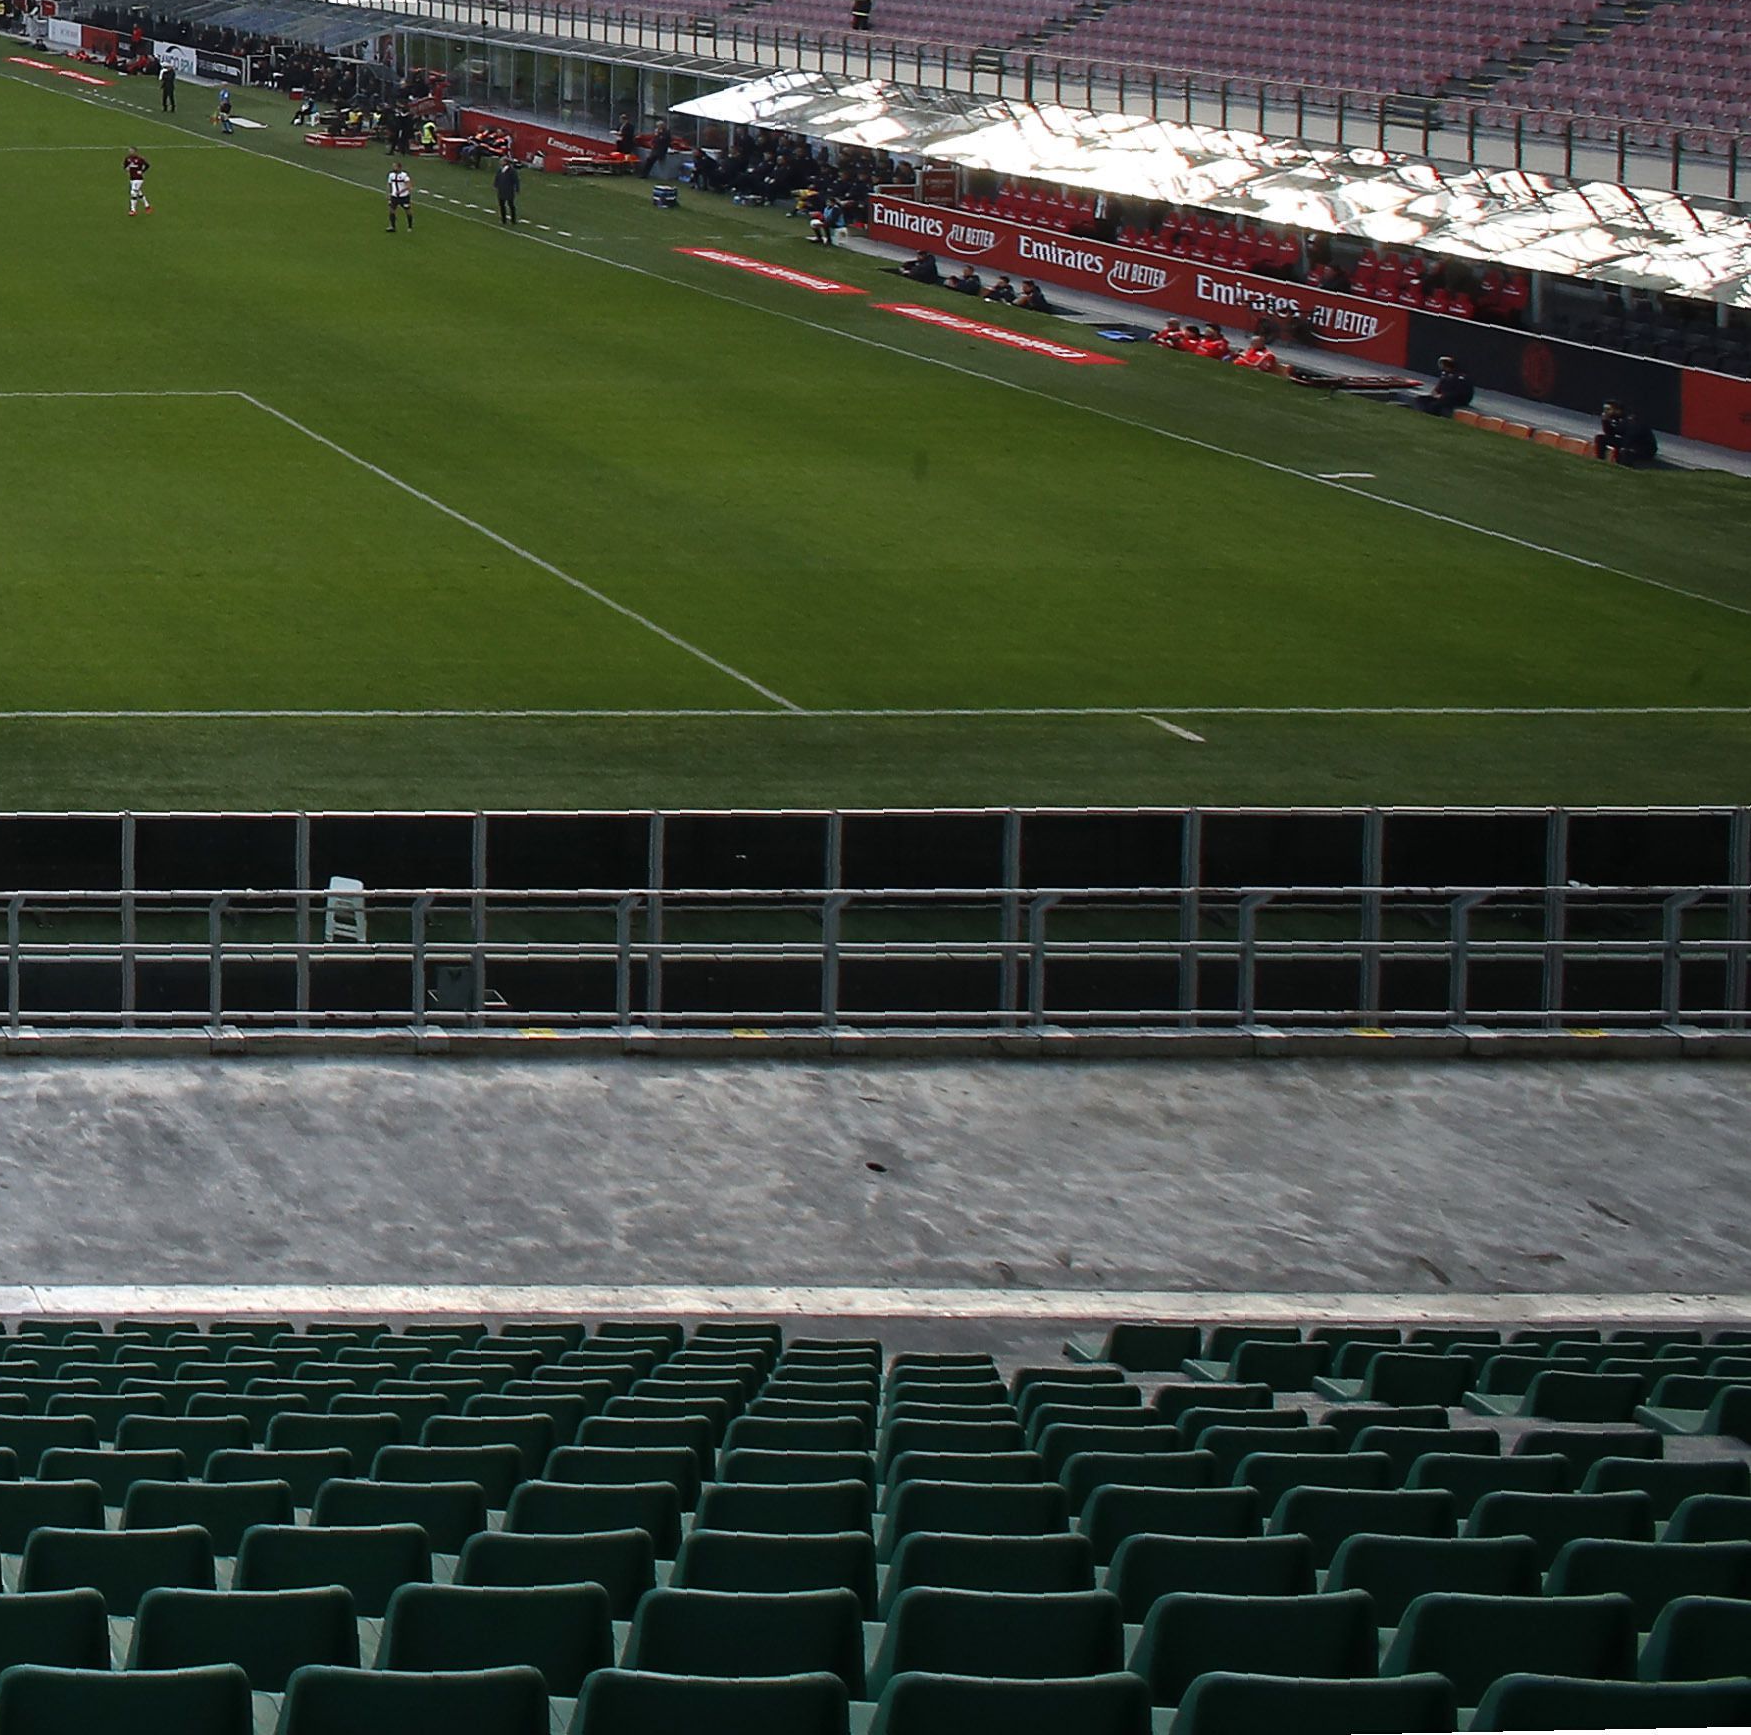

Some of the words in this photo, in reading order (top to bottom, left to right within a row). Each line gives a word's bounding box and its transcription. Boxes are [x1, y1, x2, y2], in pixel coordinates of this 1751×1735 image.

[872, 203, 944, 237] Emirates
[951, 223, 965, 243] FLY
[965, 226, 996, 248] BETTER
[1018, 235, 1104, 274] Emirates
[1113, 260, 1131, 281] FLY
[1132, 264, 1167, 287] BETTER
[1197, 274, 1300, 318] Emirates
[1312, 305, 1332, 328] FLY
[1334, 308, 1379, 337] BETTER
